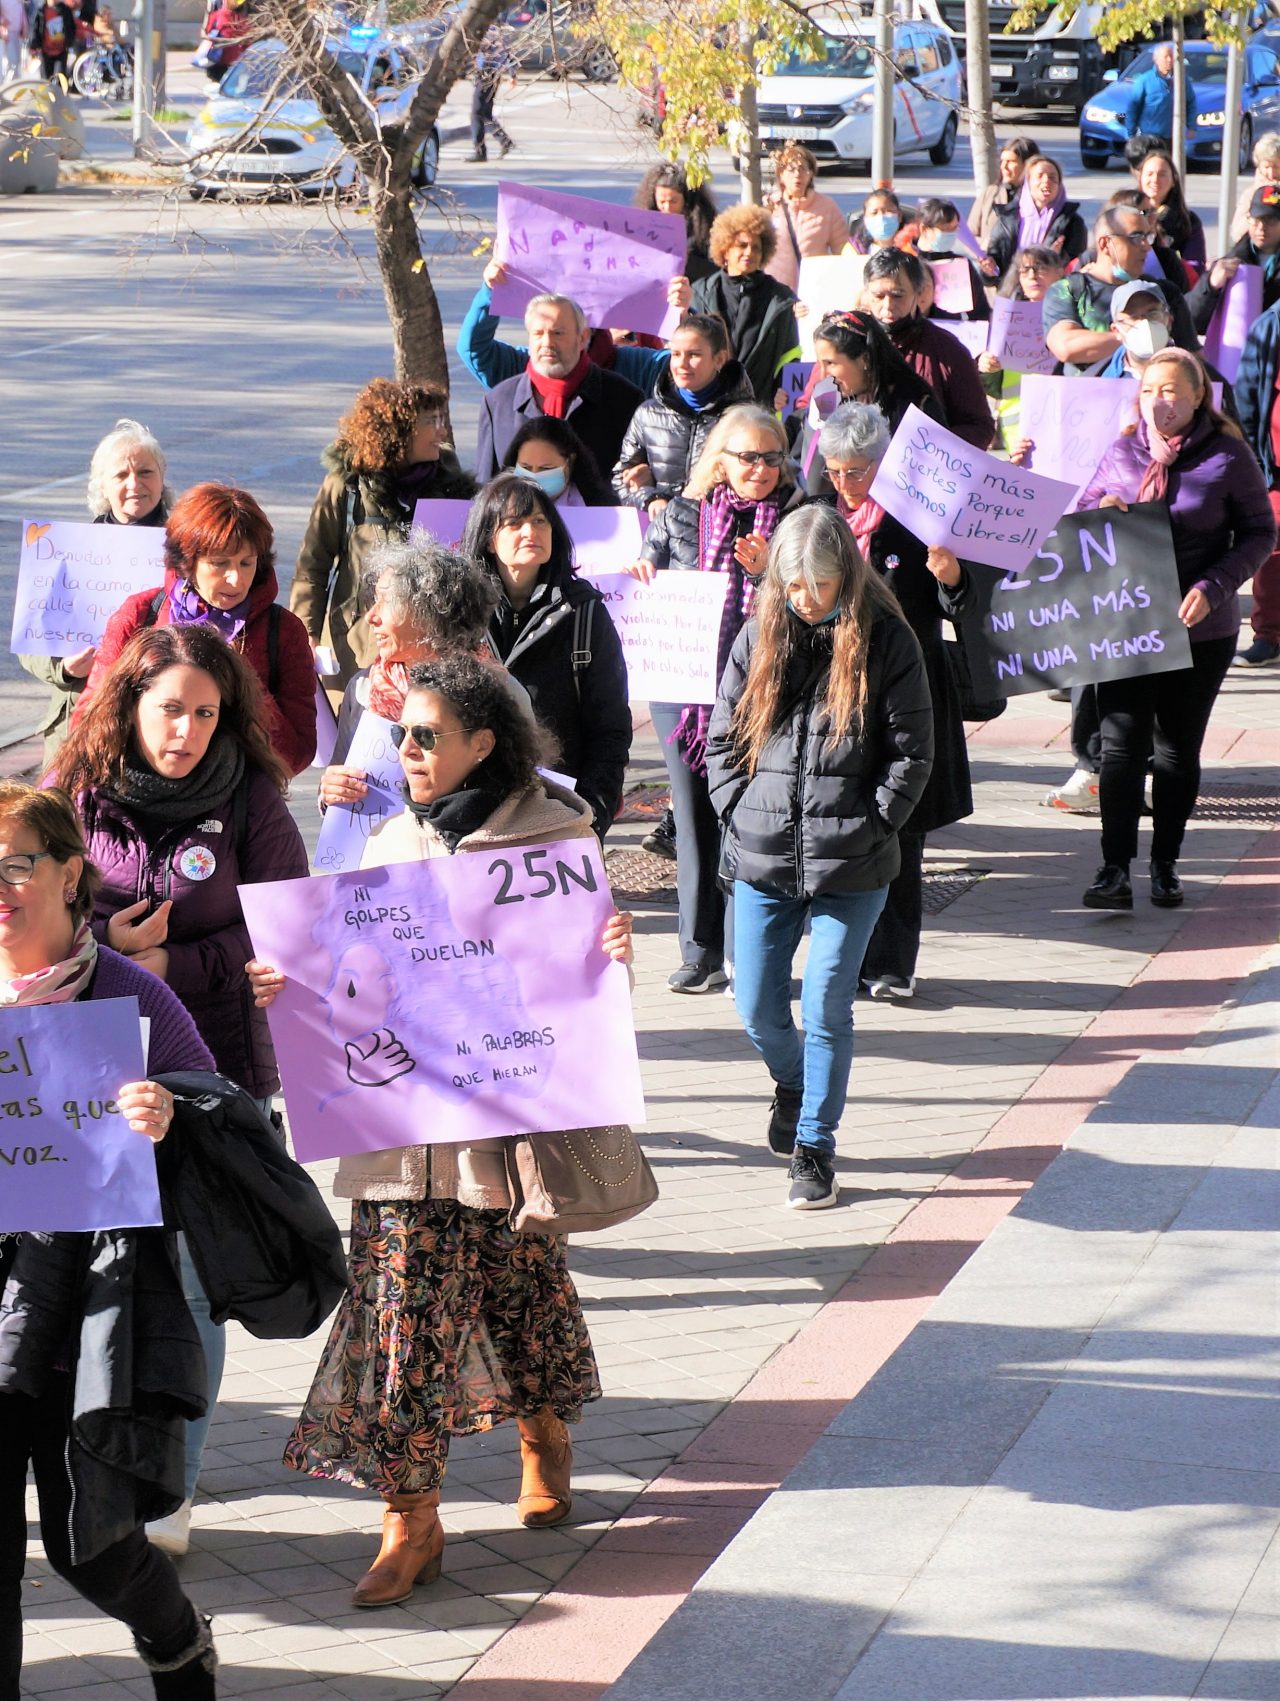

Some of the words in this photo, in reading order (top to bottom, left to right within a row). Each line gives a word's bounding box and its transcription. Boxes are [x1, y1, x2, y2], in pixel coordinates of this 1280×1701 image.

[910, 426, 973, 479] Somos
[983, 473, 1035, 501] más
[901, 446, 957, 495] fuertes
[967, 492, 1025, 521] Porque
[894, 471, 947, 518] Somos
[950, 507, 1038, 549] Libres!!
[33, 574, 55, 588] en
[62, 572, 81, 590] la
[85, 578, 132, 593] cama
[27, 597, 74, 615] calle
[990, 610, 1015, 633] NI
[1028, 597, 1080, 627] UNA
[1092, 577, 1152, 616] MÁS
[24, 627, 105, 646] nuestra
[997, 652, 1023, 681] NI
[1033, 643, 1078, 672] UNA
[1089, 629, 1165, 662] MENOS
[487, 849, 599, 905] 25N
[354, 886, 371, 902] NI
[344, 905, 411, 931] GOLPES
[392, 926, 425, 941] QUE
[411, 938, 495, 962] DUELAN
[481, 1027, 555, 1052] PALABRAS
[452, 1068, 483, 1088] QUE
[493, 1065, 538, 1081] HIERAN
[63, 1098, 119, 1130] que
